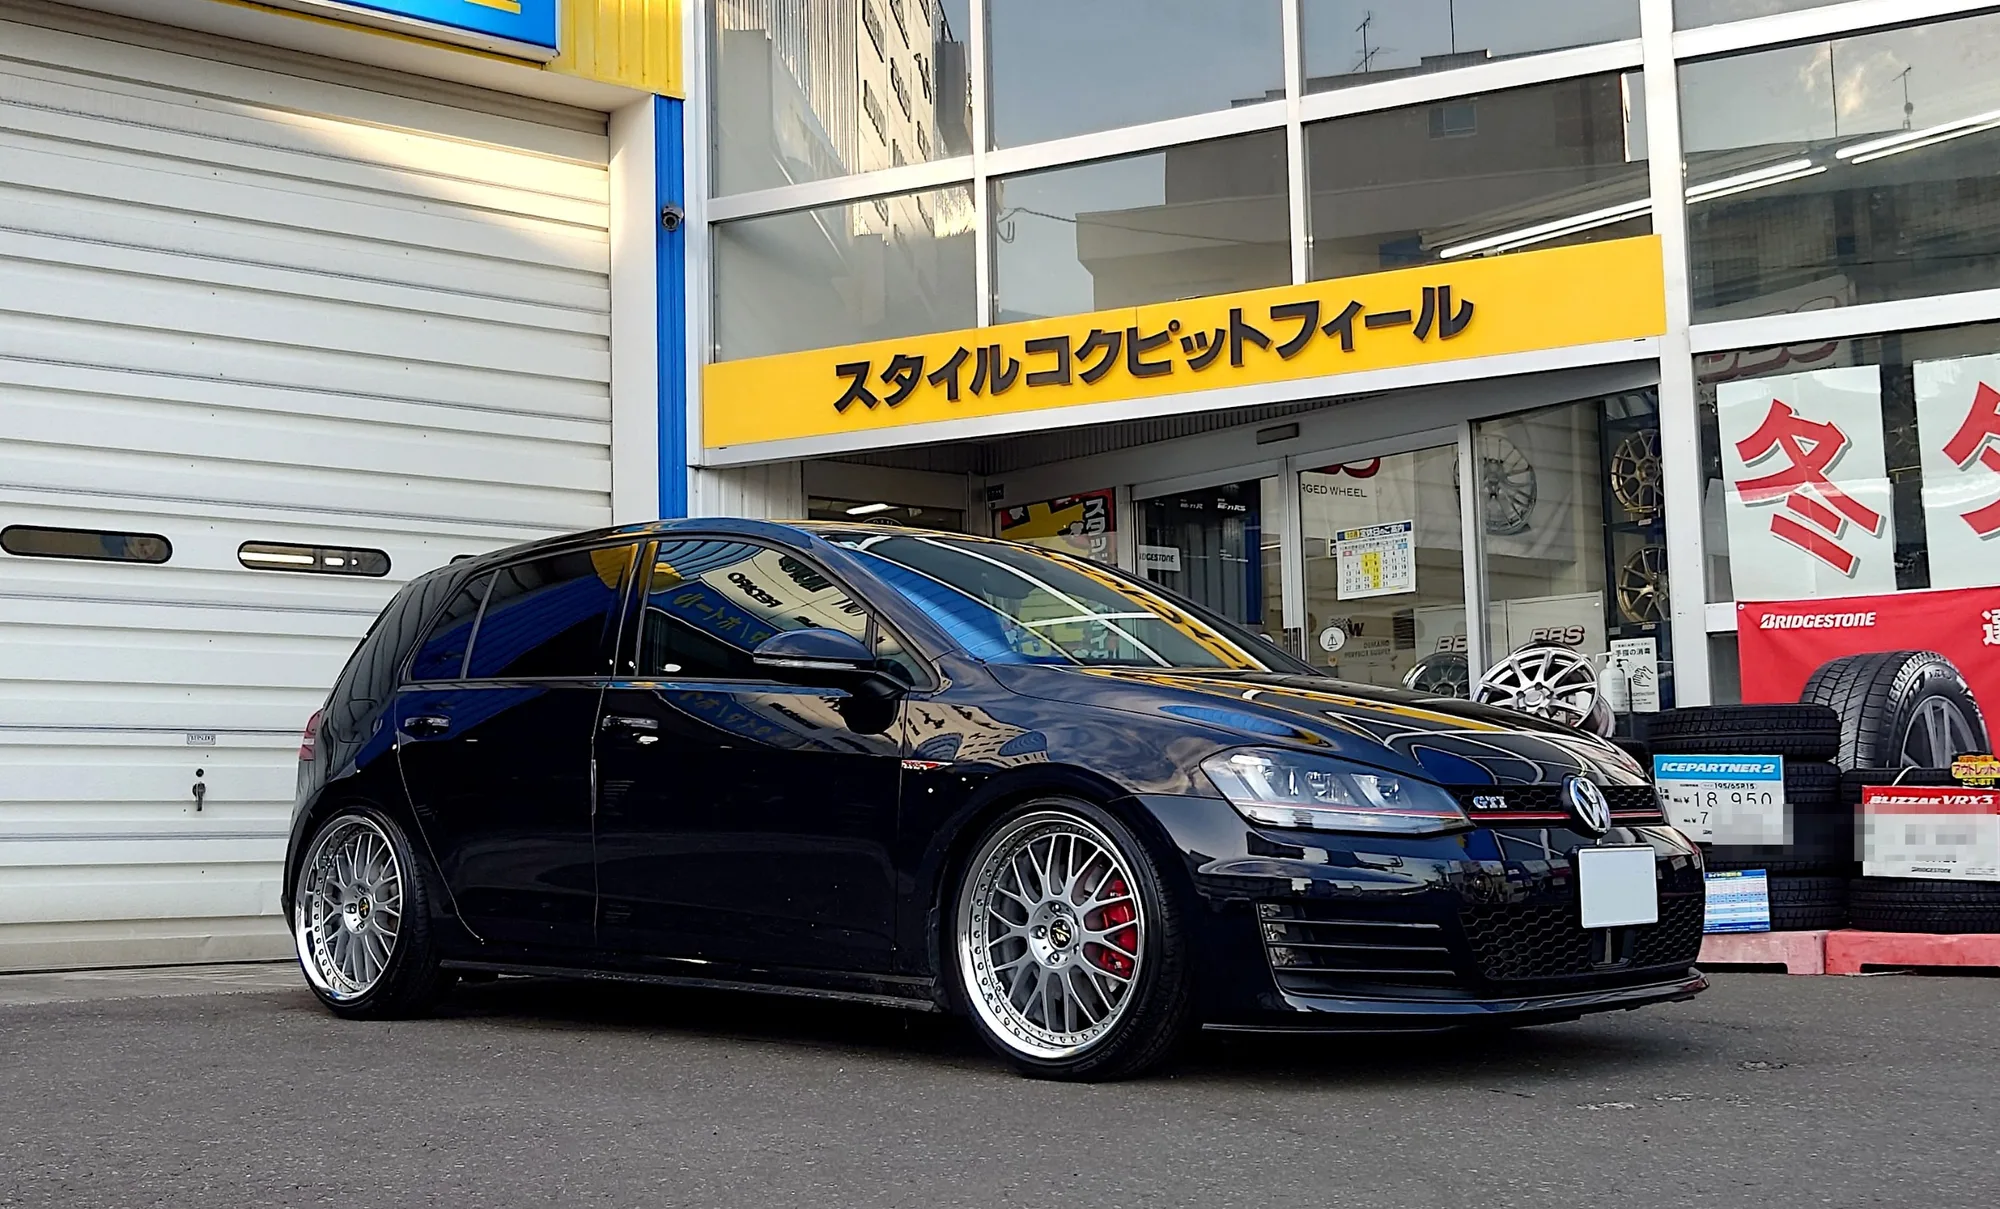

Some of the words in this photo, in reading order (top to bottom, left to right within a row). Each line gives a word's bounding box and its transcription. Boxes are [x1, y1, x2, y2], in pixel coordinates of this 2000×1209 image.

[833, 285, 1474, 413] スタイルコクピットフィール
[1329, 487, 1367, 498] WHEEL
[1735, 398, 1884, 577] 冬
[1760, 612, 1877, 629] BRIDGESTONE
[1529, 625, 1585, 645] BBS
[1661, 762, 1761, 773] ICEPARTNER
[1761, 763, 1776, 773] 2
[1953, 765, 2000, 777] アウトレット
[1472, 795, 1508, 809] GTI
